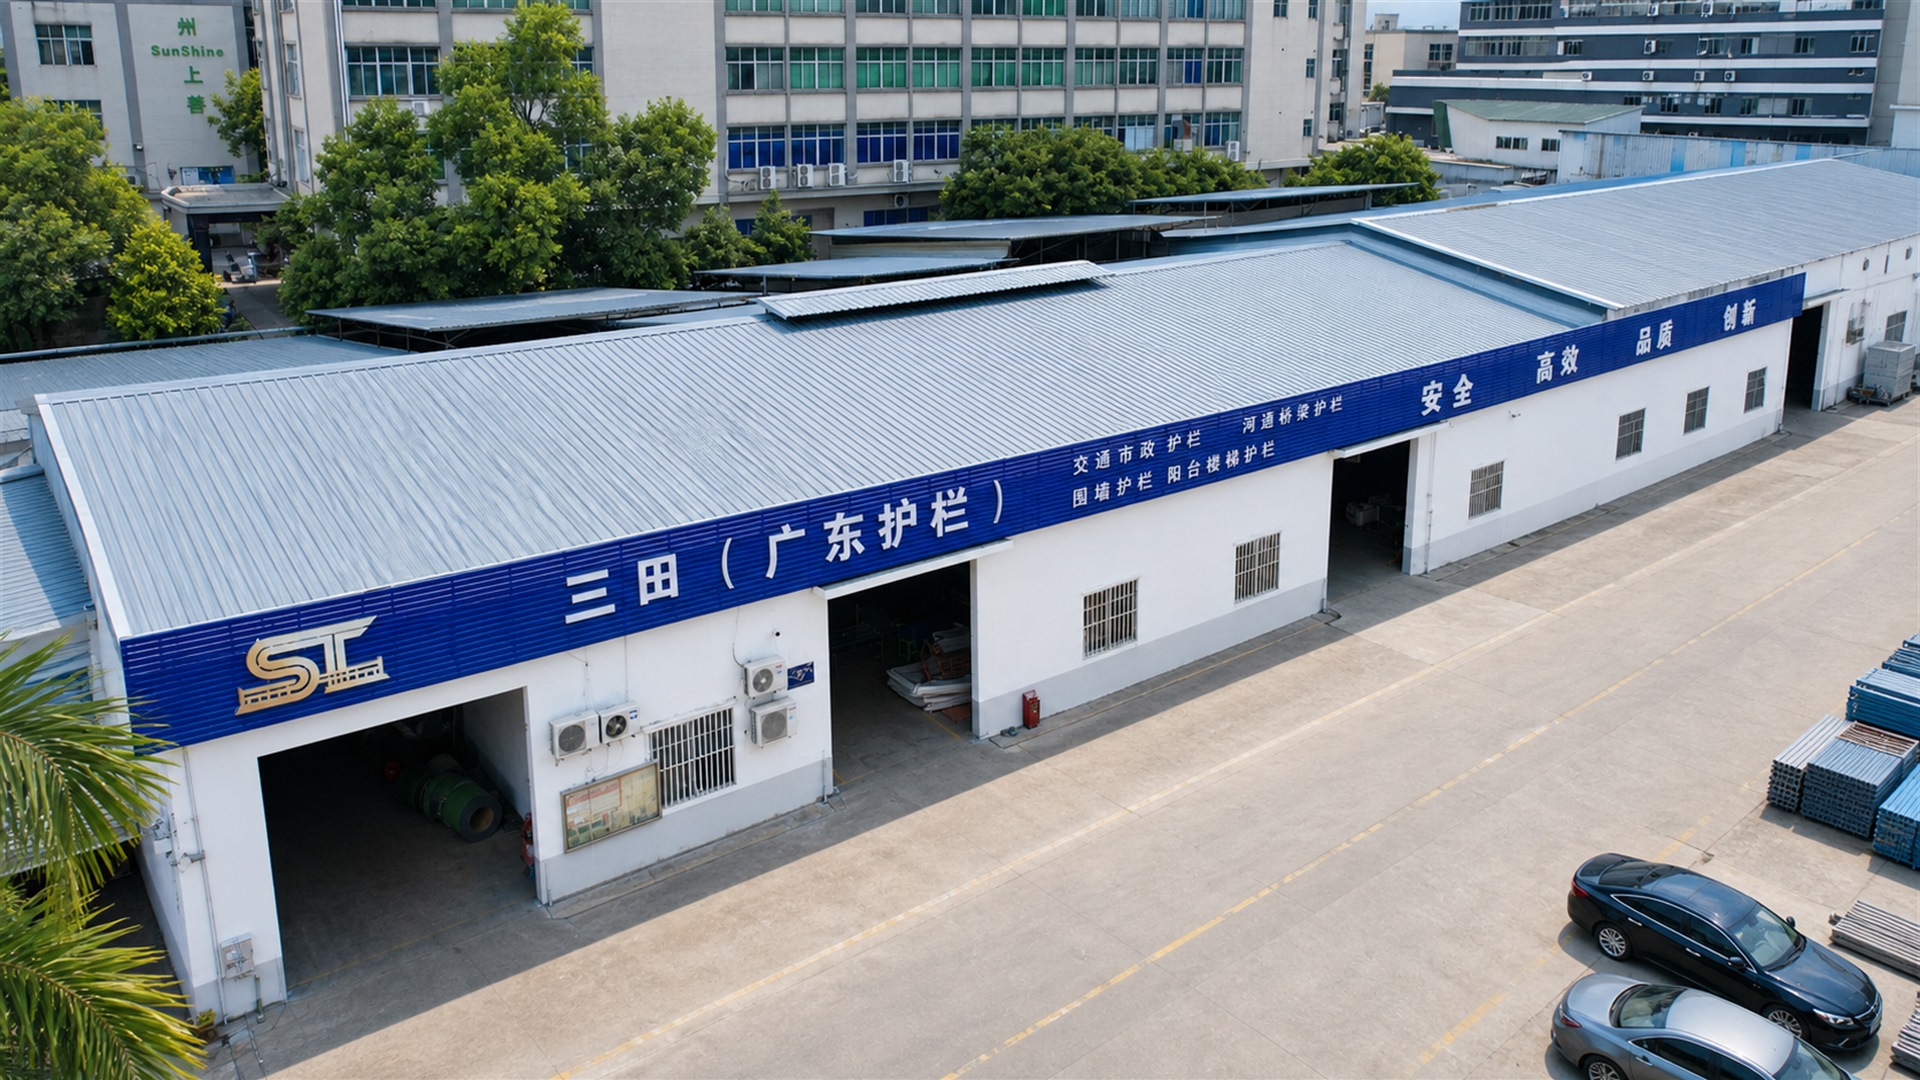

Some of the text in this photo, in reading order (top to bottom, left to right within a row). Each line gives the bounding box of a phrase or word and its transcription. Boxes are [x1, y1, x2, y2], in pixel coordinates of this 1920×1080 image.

[151, 45, 224, 57] SunShine
[1421, 298, 1756, 416] 安全 高效 品质 创新
